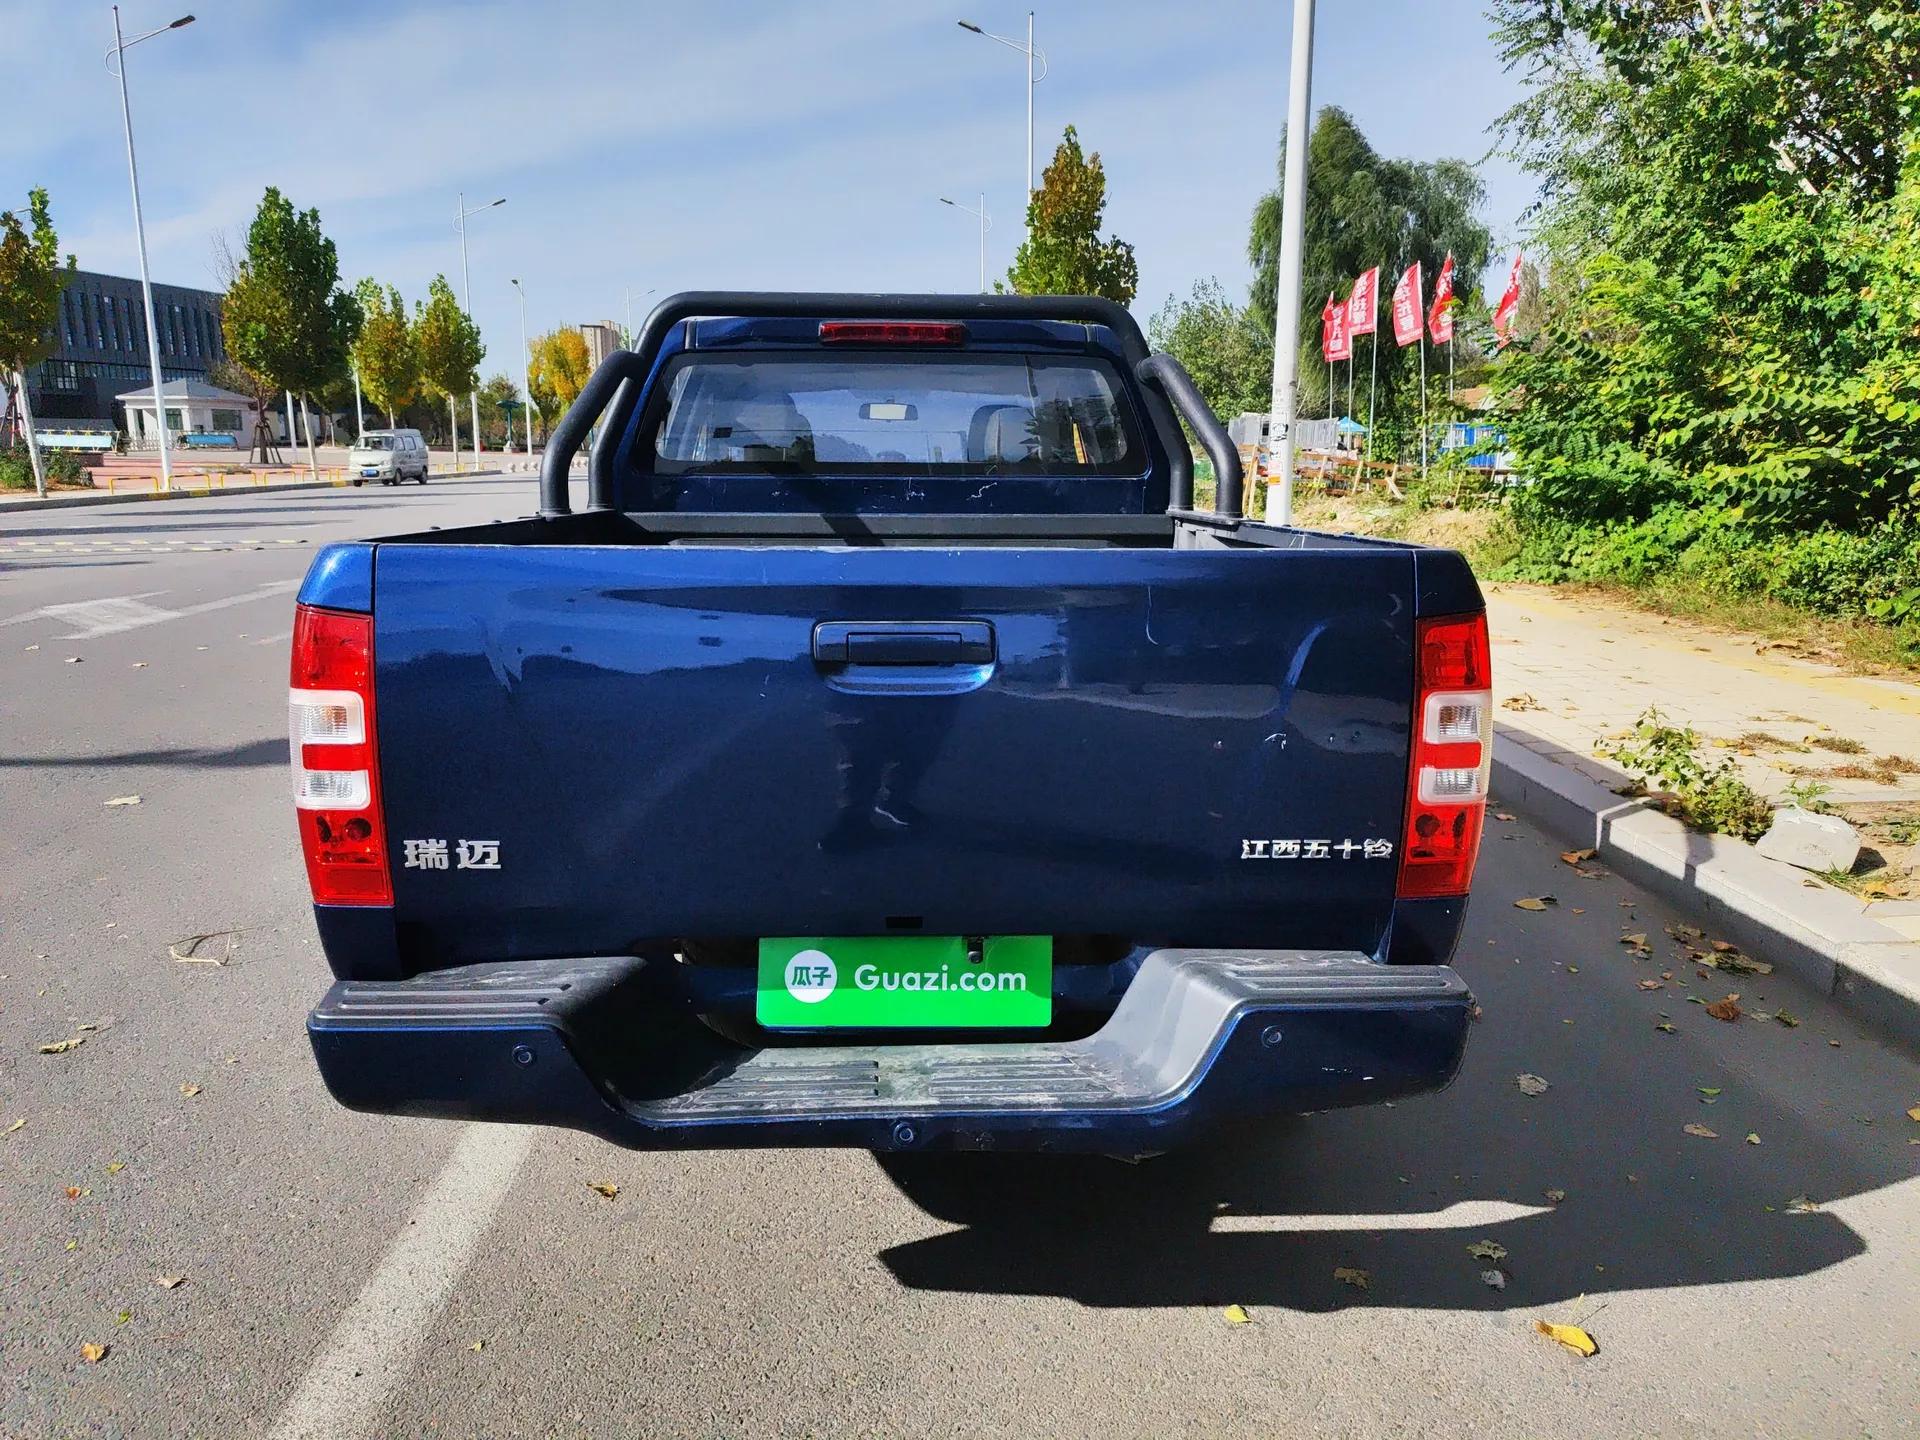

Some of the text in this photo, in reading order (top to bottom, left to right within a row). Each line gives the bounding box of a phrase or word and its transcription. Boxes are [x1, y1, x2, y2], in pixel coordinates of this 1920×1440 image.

[403, 838, 502, 870] 瑞迈
[1240, 838, 1394, 860] 江西五十铃
[791, 965, 832, 987] 瓜子
[854, 963, 1027, 992] Guazi.com
